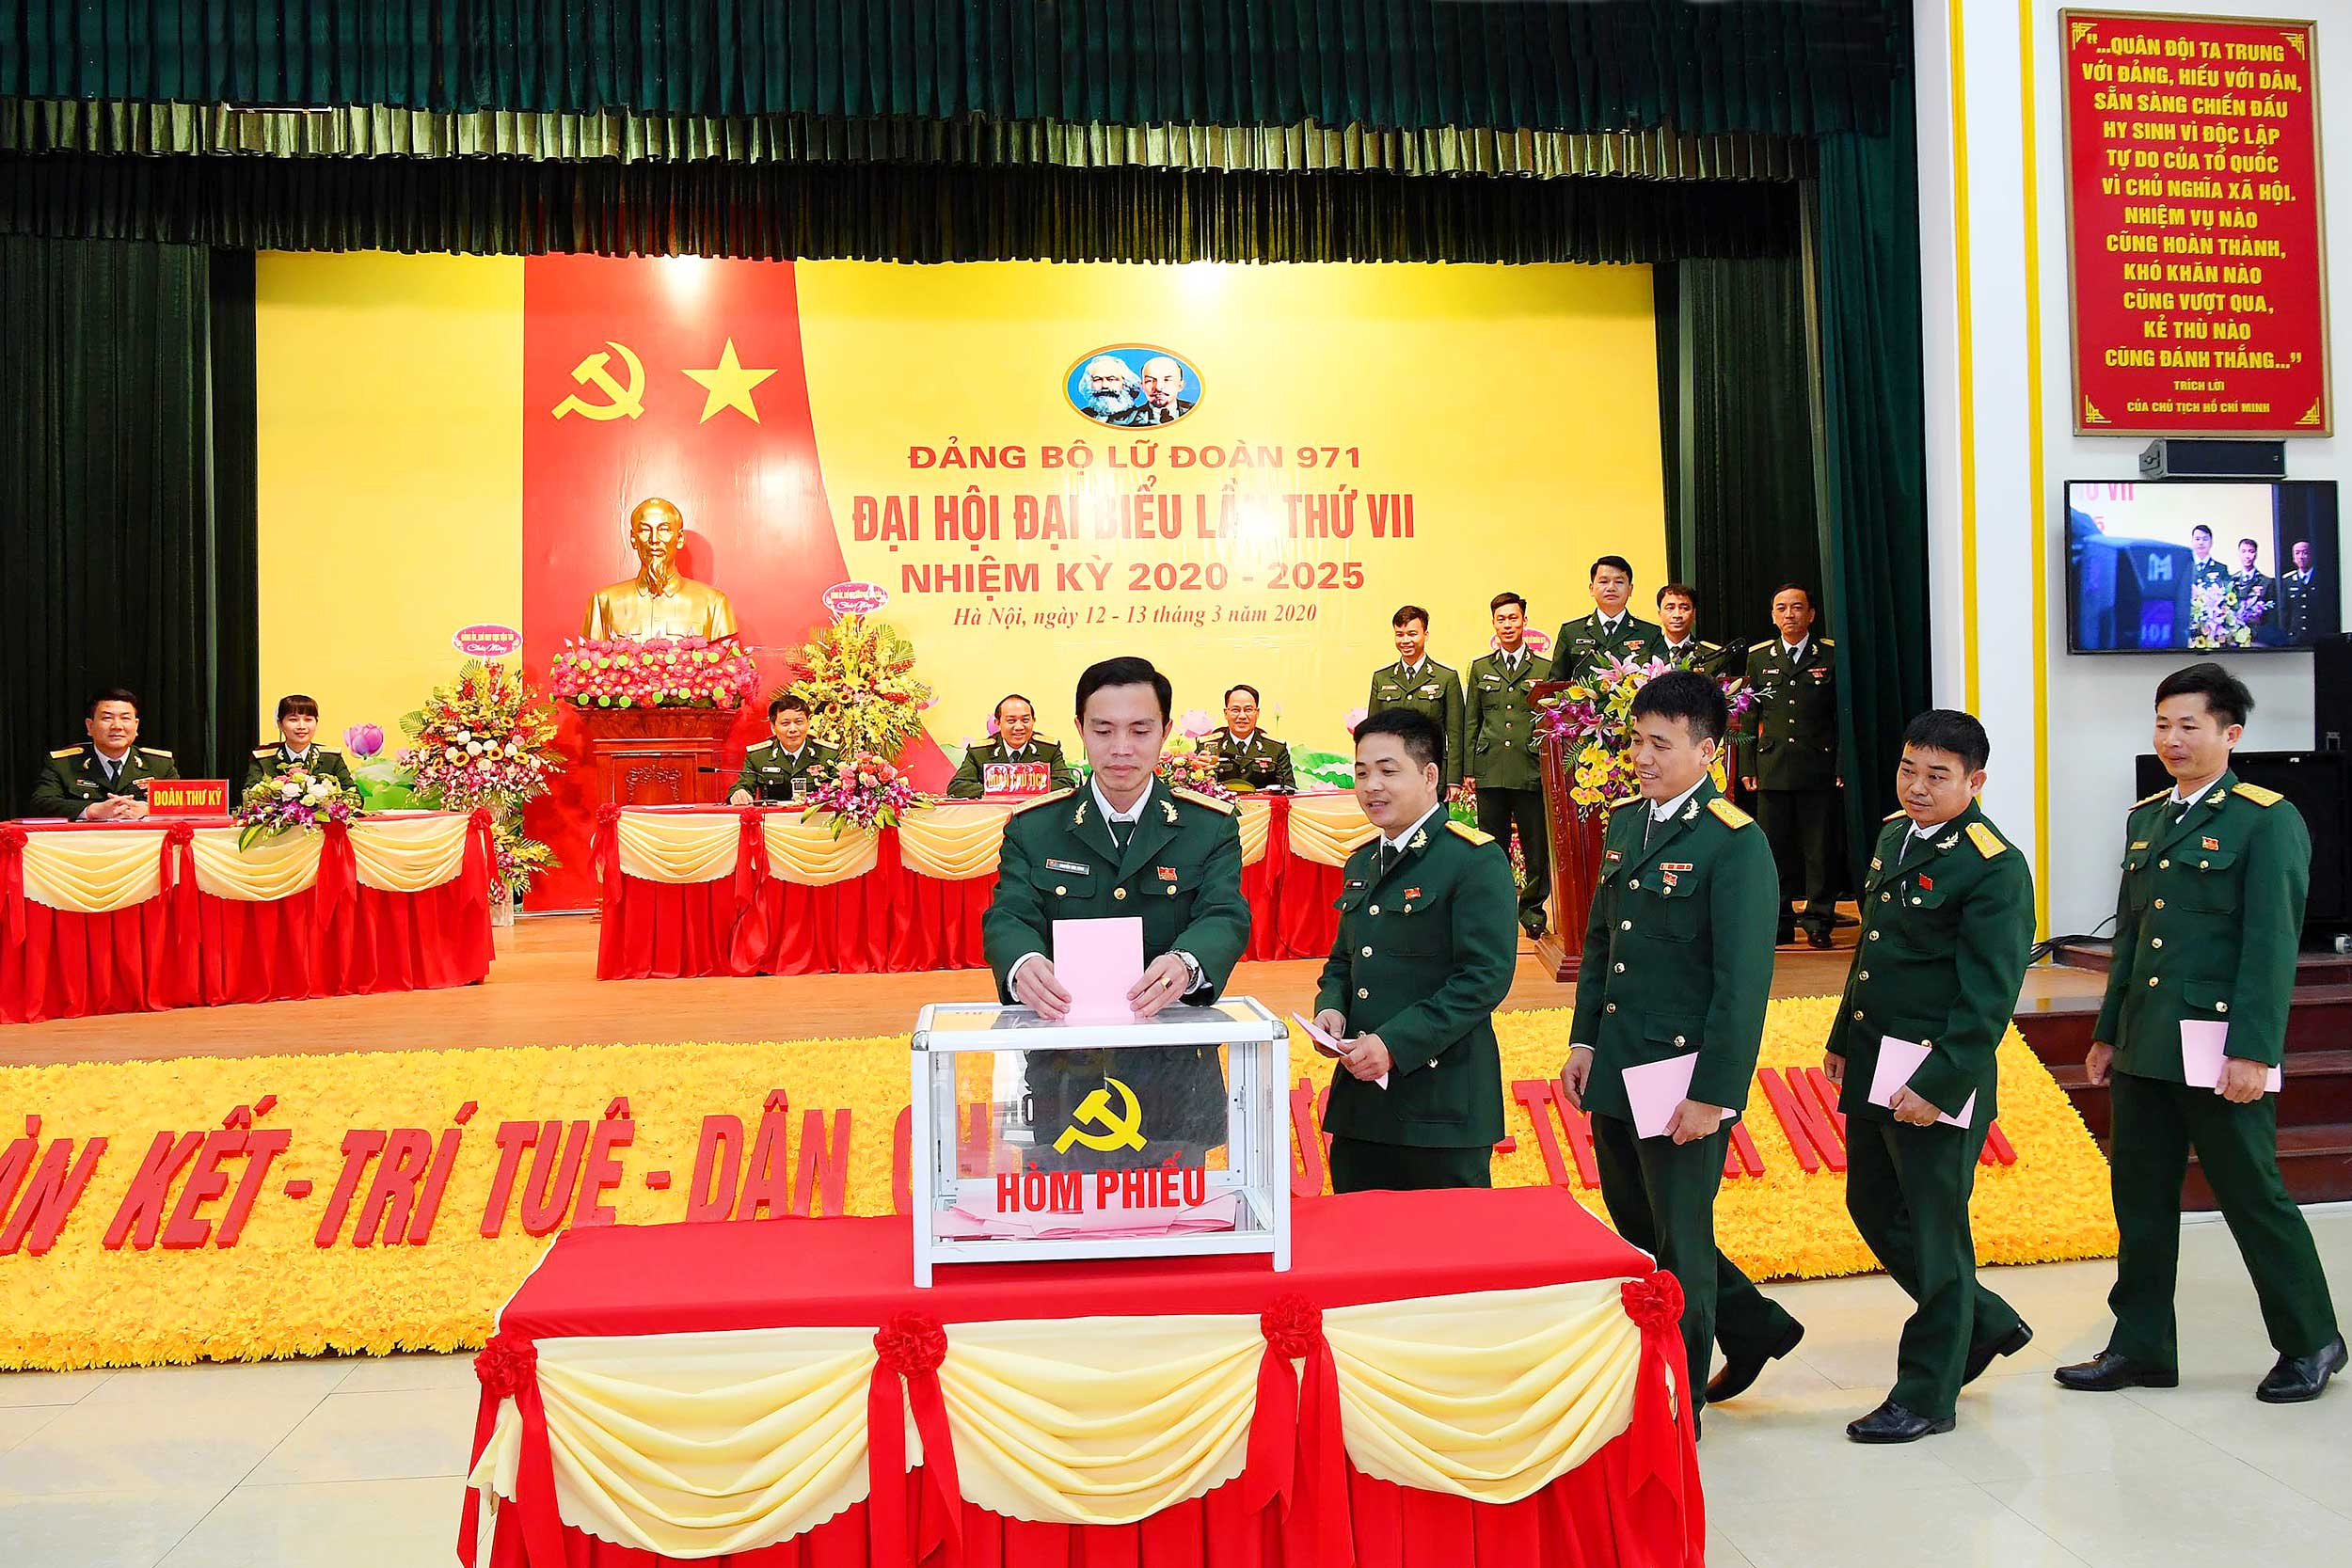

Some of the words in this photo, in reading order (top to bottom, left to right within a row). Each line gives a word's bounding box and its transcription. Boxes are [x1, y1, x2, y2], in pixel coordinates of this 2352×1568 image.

[2165, 36, 2195, 61] ĐỘI
[2199, 40, 2221, 59] TA
[2225, 41, 2284, 63] TRUNG
[2082, 62, 2113, 82] VỚI
[2117, 59, 2174, 87] ĐẢNG,
[2178, 62, 2219, 87] HIẾU
[2225, 70, 2254, 89] VỚI
[2259, 71, 2302, 93] DÂN,
[2094, 86, 2134, 111] SẴN
[2137, 90, 2187, 114] SÀNG
[2192, 92, 2246, 117] CHIẾN
[2250, 94, 2288, 119] ĐẤU
[2103, 121, 2128, 139] HY
[2133, 123, 2176, 141] SINH
[2180, 123, 2199, 141] VÌ
[2202, 123, 2239, 146] ĐỘC
[2245, 124, 2280, 150] LẬP
[2106, 149, 2131, 171] TỰ
[2135, 150, 2159, 169] DO
[2164, 147, 2200, 171] CỦA
[2203, 145, 2227, 172] TỔ
[2230, 148, 2279, 173] QUỐC
[2102, 177, 2121, 196] VÌ
[2125, 173, 2163, 198] CHỦ
[2168, 177, 2222, 198] NGHĨA
[2228, 180, 2253, 200] XÃ
[2259, 181, 2296, 206] HỘI.
[2124, 205, 2185, 230] NHIỆM
[2190, 209, 2214, 231] VỤ
[2219, 208, 2258, 229] NÀO
[2106, 230, 2158, 253] CŨNG
[2163, 233, 2214, 255] HOÀN
[2218, 236, 2286, 260] THÀNH,
[2124, 260, 2162, 281] KHÓ
[2167, 262, 2218, 283] KHĂN
[2223, 263, 2262, 285] NÀO
[2123, 289, 2174, 310] CŨNG
[2179, 293, 2225, 315] VƯỢT
[2230, 294, 2274, 314] QUA,
[2144, 314, 2168, 339] KẺ
[2173, 318, 2207, 340] THÙ
[2213, 319, 2251, 341] NÀO
[2106, 348, 2155, 368] CŨNG
[2159, 347, 2210, 369] ĐÁNH
[2174, 379, 2205, 390] TRÍCH
[2208, 381, 2225, 392] LỜI
[2127, 401, 2148, 413] CỦA
[2152, 401, 2172, 413] CHỦ
[2177, 403, 2200, 416] TỊCH
[2202, 399, 2217, 413] HỒ
[2220, 402, 2238, 413] CHÍ
[2242, 403, 2270, 413] MINH
[908, 436, 1026, 468] ĐẢNG
[1041, 438, 1093, 476] BỘ
[1108, 438, 1159, 468] LỮ
[1168, 439, 1283, 468] ĐOÀN
[1296, 447, 1359, 468] 971
[852, 495, 918, 552] ĐẠI
[934, 484, 999, 552] HỘI
[1013, 494, 1079, 551] ĐẠI
[1282, 483, 1358, 539] THỨ
[1366, 494, 1415, 538] VII
[901, 555, 1040, 601] NHIỆM
[1057, 554, 1113, 592] KỲ
[1129, 562, 1228, 591] 2020
[1267, 562, 1364, 590] 2025
[953, 607, 981, 626] Hà
[987, 606, 1026, 629] Nội,
[1034, 608, 1078, 629] ngày
[1085, 606, 1106, 624] 12
[1127, 605, 1146, 623] 13
[1153, 605, 1205, 627] tháng
[1212, 605, 1221, 623] 3
[1229, 605, 1266, 623] năm
[1274, 604, 1317, 622] 2020
[153, 787, 183, 806] ĐOÀN
[185, 788, 207, 806] THƯ
[208, 786, 222, 806] KÝ
[101, 1094, 293, 1251] KẾT
[313, 1100, 478, 1249] TRÍ
[685, 1088, 852, 1223] DÂN
[996, 1161, 1083, 1213] HÒM
[1096, 1149, 1206, 1210] PHIẾU
